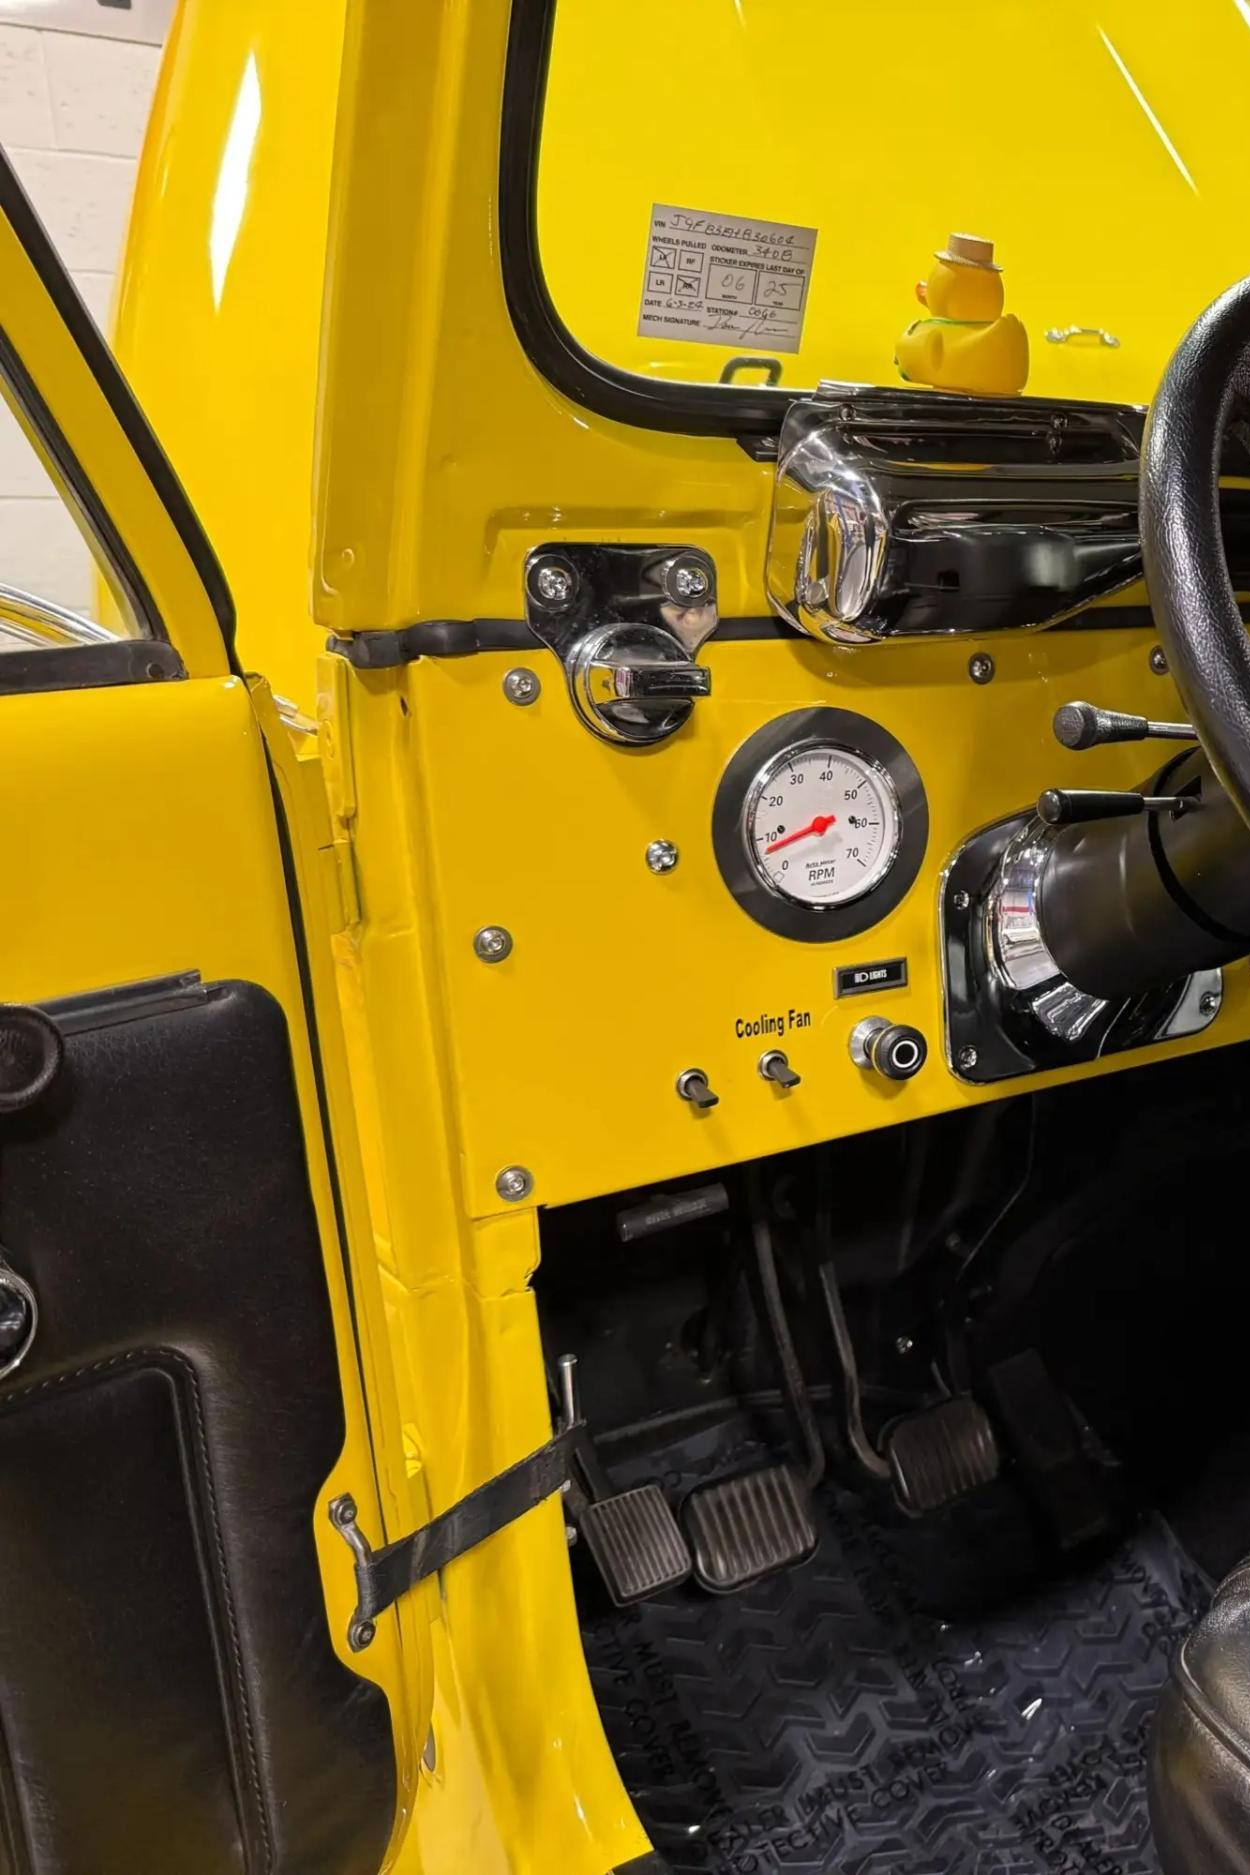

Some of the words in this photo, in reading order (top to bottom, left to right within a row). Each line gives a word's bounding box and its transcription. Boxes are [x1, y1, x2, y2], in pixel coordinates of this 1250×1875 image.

[654, 219, 666, 229] VIN
[652, 235, 681, 247] WHEELS
[681, 239, 707, 251] PULLED
[711, 243, 748, 256] ODOMETER
[710, 255, 739, 266] STICKER
[738, 260, 765, 272] EXPIRES
[765, 264, 782, 274] LAST
[782, 267, 796, 276] DAY
[795, 269, 806, 278] OF
[644, 298, 663, 308] DATE
[642, 313, 663, 323] MECH
[663, 317, 701, 328] SIGNATURE
[790, 773, 804, 785] 30
[819, 772, 833, 782] 40
[769, 794, 784, 807] 20
[844, 789, 858, 801] 50
[765, 831, 778, 842] 10
[846, 846, 859, 859] 70
[781, 860, 789, 871] 0
[808, 867, 835, 881] RPM
[735, 1013, 785, 1039] Cooling
[788, 1008, 811, 1030] Fan
[871, 1761, 948, 1809] COVER
